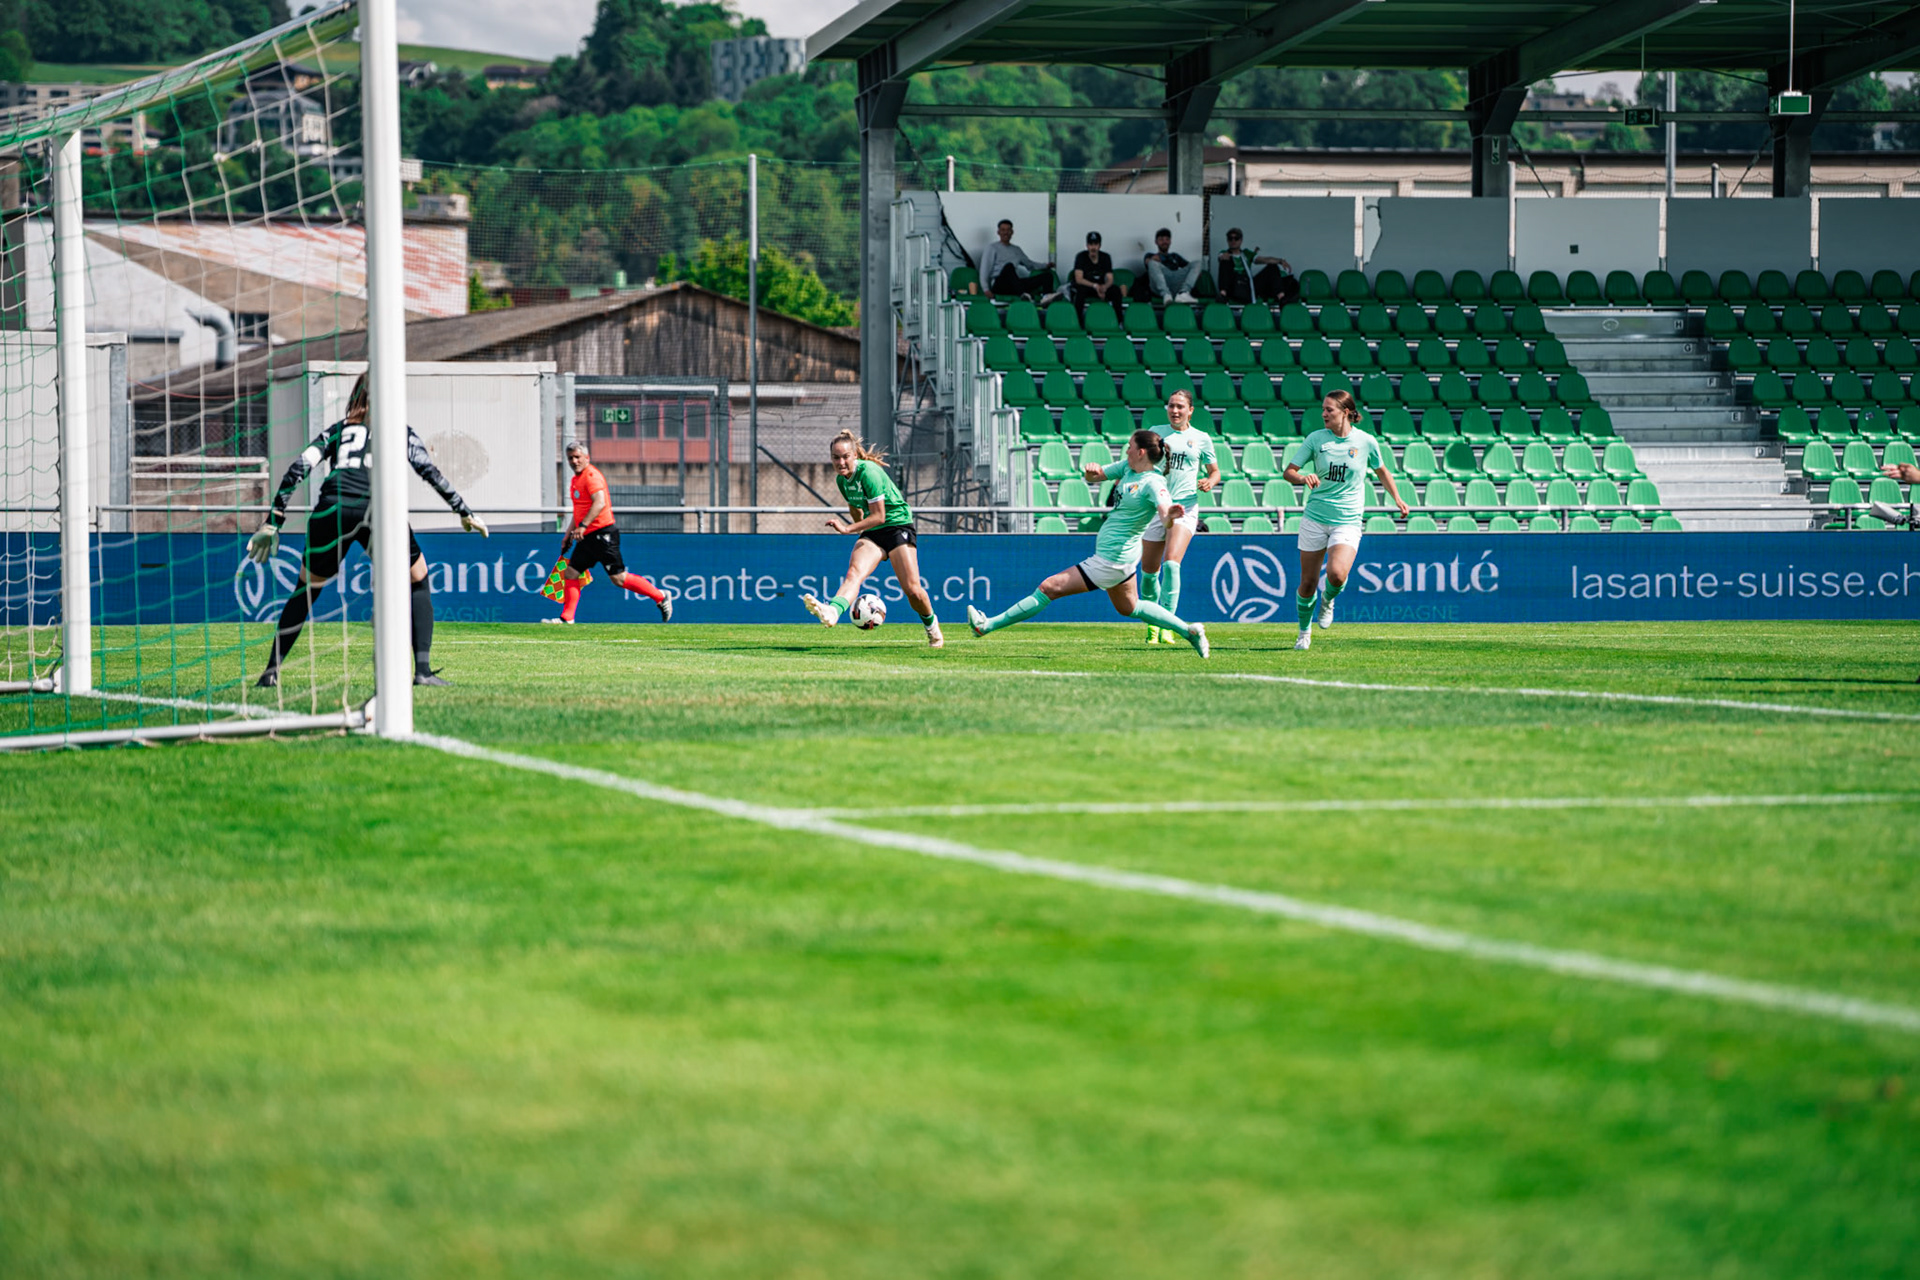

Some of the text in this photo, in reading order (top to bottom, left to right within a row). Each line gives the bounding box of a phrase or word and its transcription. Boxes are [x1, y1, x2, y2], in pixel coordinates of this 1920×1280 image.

[336, 425, 373, 469] 2
[1170, 451, 1187, 470] ost
[428, 549, 546, 594] anté
[1357, 549, 1499, 593] santé
[1572, 563, 1920, 600] lasante-suisse.ch
